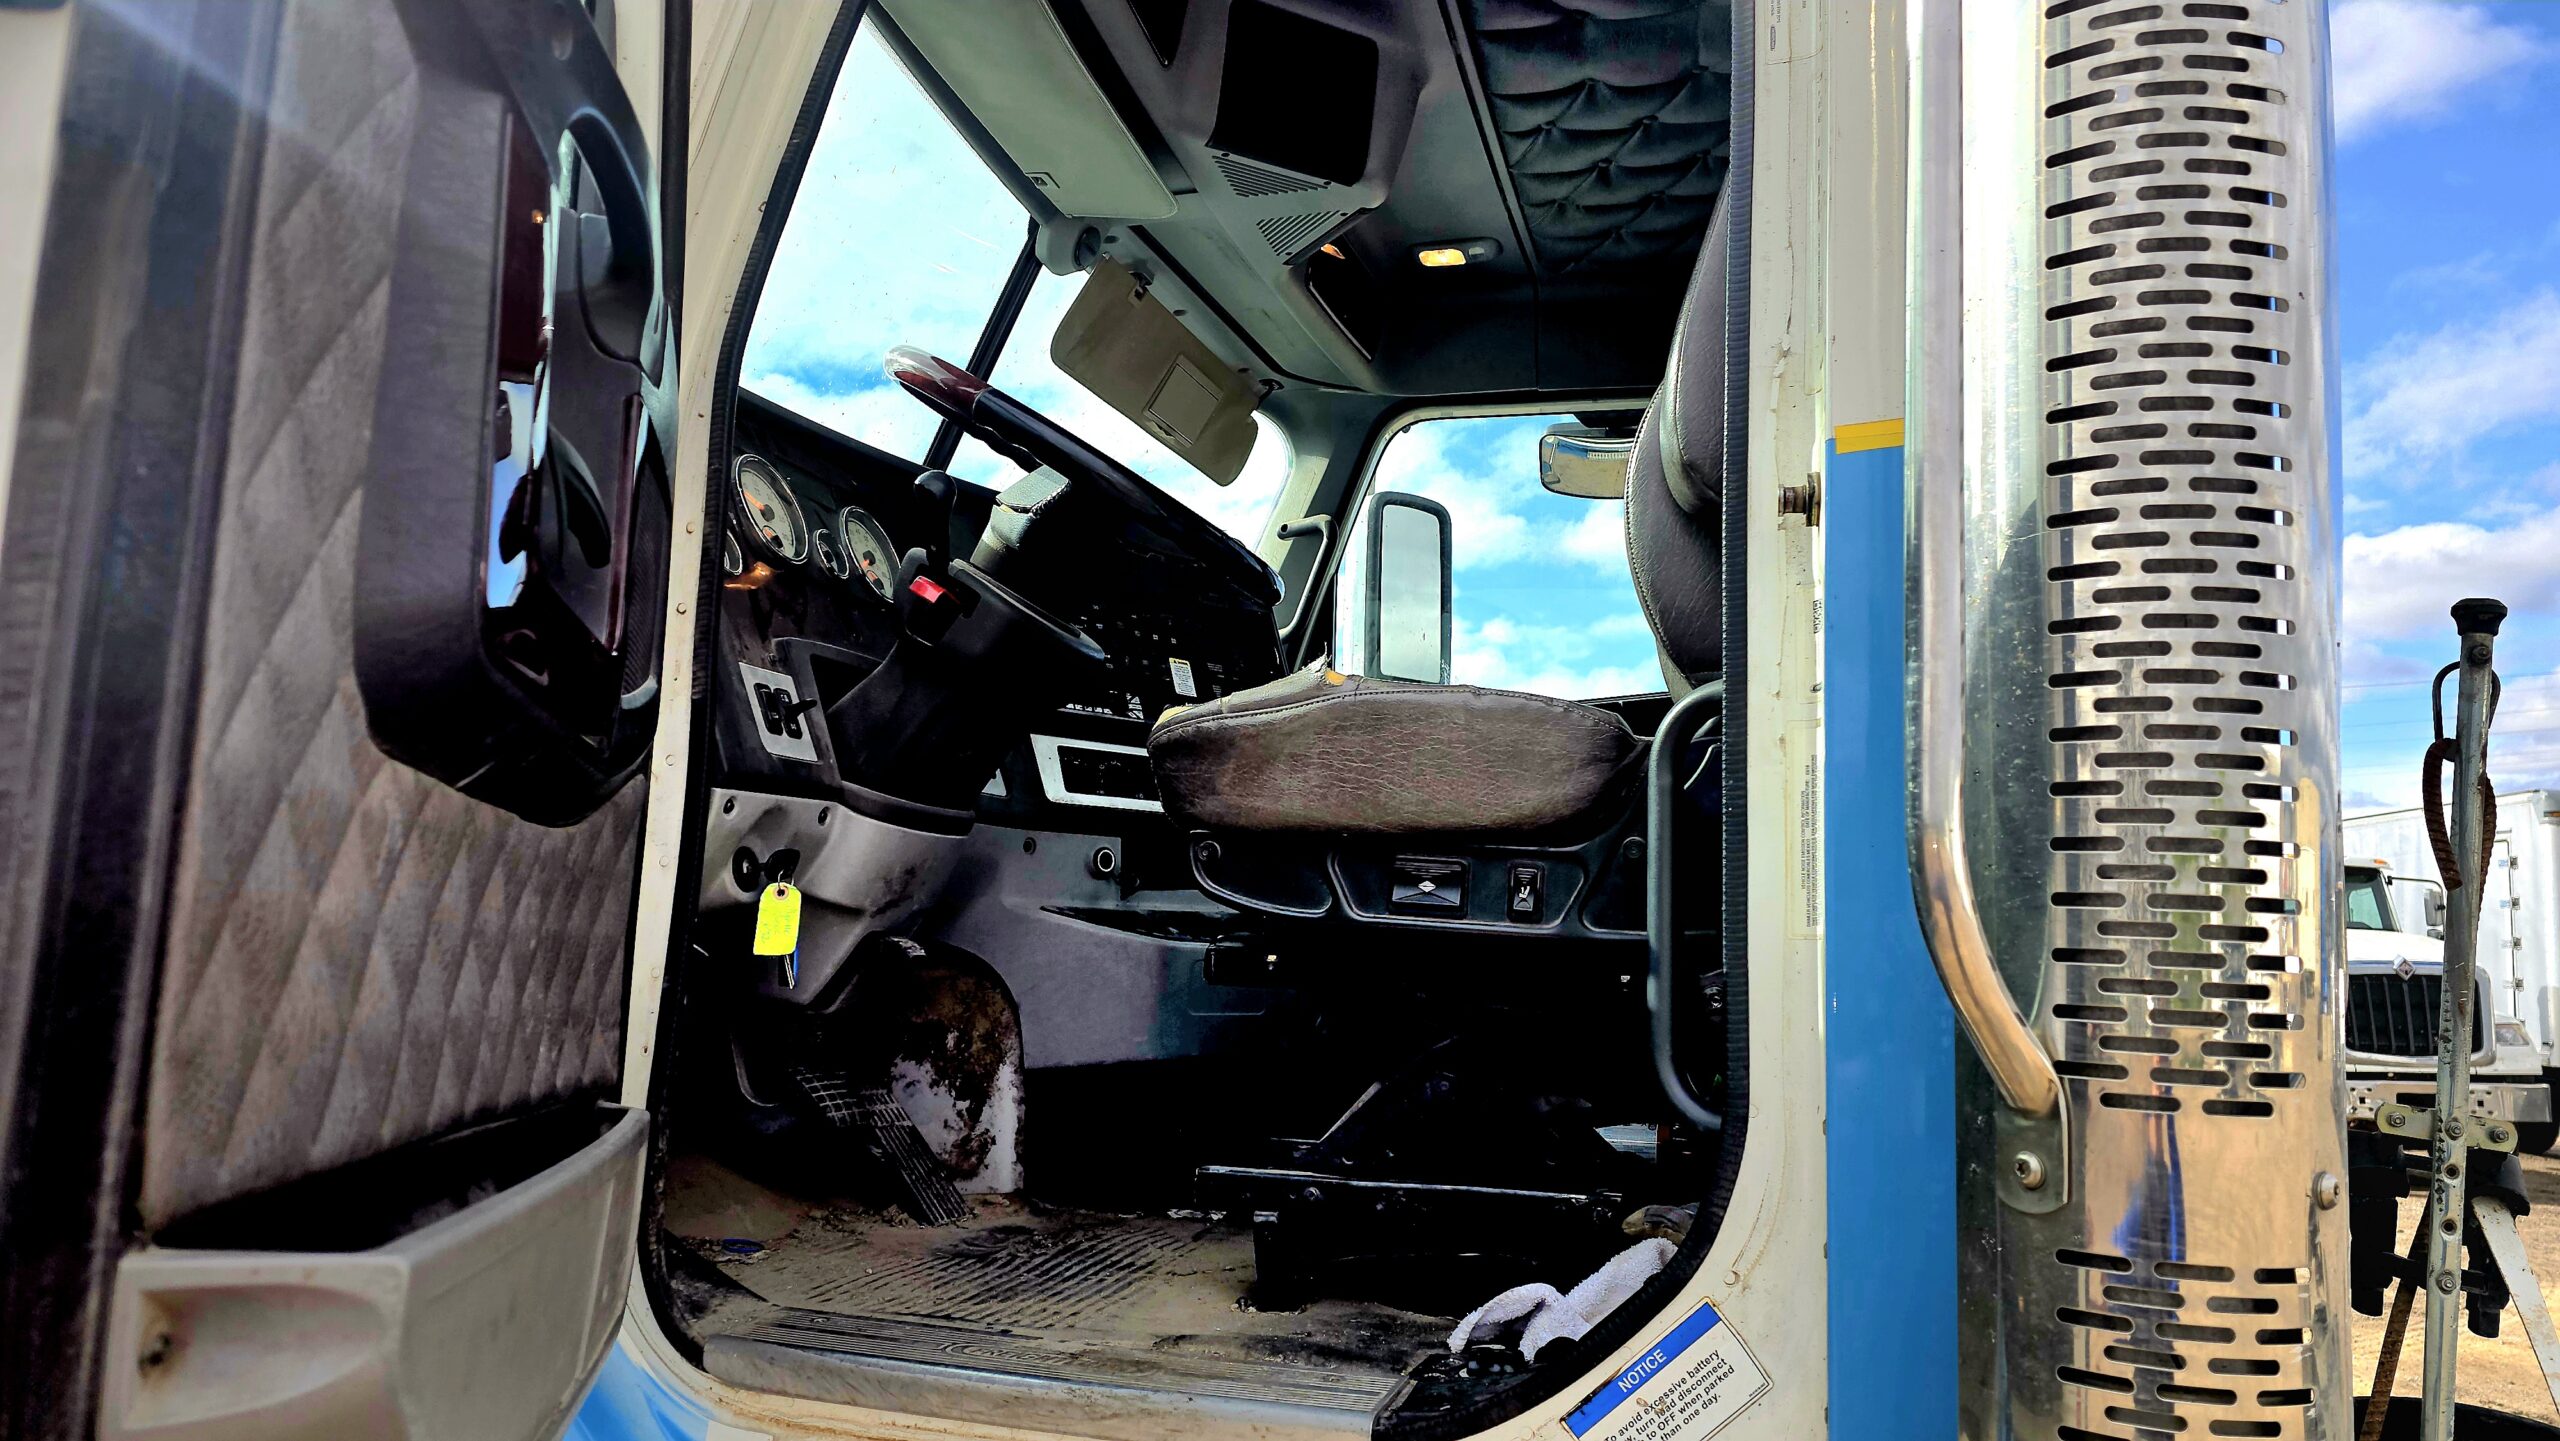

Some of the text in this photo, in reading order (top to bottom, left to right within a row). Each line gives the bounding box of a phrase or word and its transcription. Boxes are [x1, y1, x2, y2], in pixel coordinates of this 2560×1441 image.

[1618, 1349, 1667, 1392] NOTICE
[1618, 1412, 1643, 1437] avoid
[1643, 1377, 1688, 1415] excessive
[1686, 1350, 1720, 1379] battery
[1635, 1418, 1656, 1435] turn
[1677, 1358, 1727, 1402] disconnect
[1646, 1430, 1657, 1441] to
[1657, 1411, 1677, 1431] OFF
[1678, 1393, 1703, 1414] when
[1704, 1365, 1735, 1395] parked
[1660, 1392, 1721, 1441] than one day.
